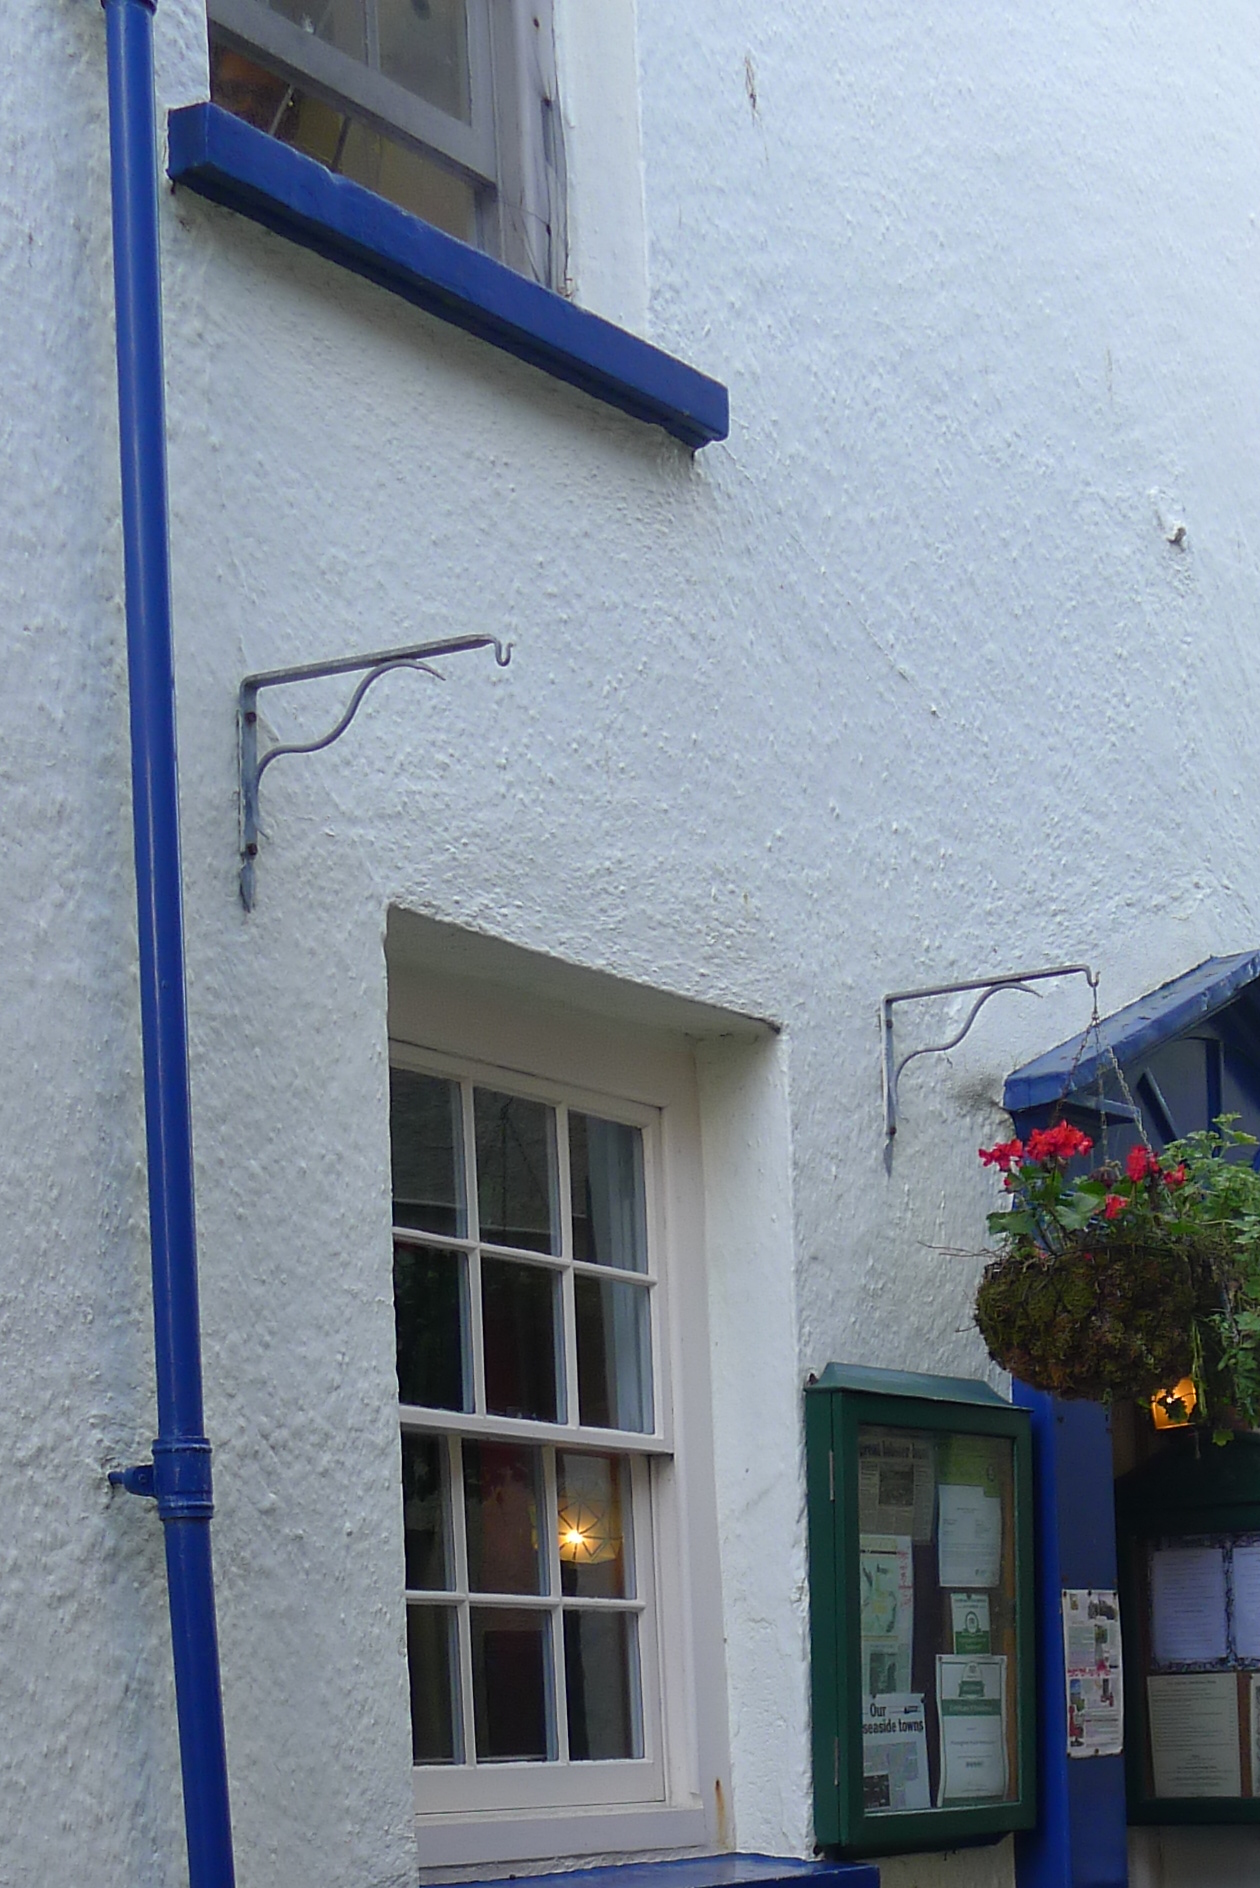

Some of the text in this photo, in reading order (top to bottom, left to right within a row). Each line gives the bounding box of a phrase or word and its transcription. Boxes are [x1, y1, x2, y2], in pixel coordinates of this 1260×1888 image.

[870, 1703, 887, 1718] Our
[863, 1719, 924, 1734] seaside towns
